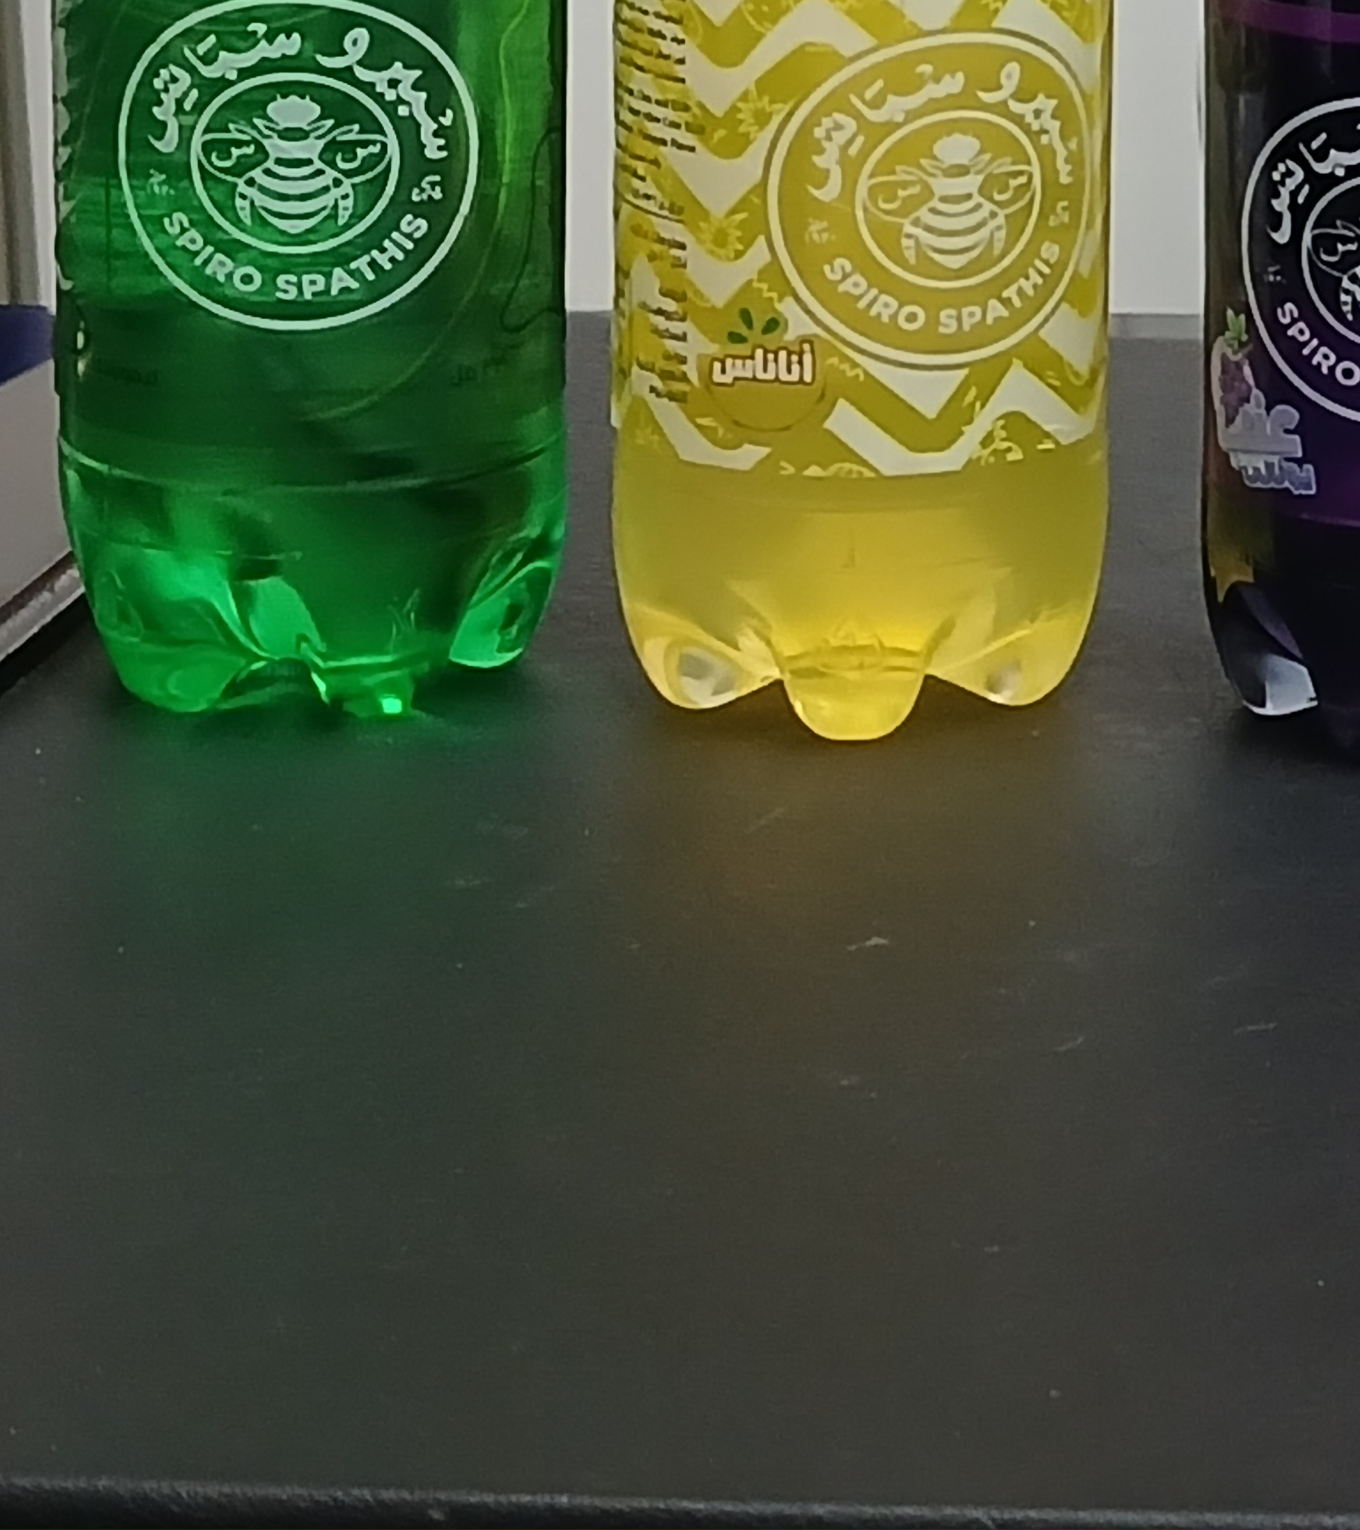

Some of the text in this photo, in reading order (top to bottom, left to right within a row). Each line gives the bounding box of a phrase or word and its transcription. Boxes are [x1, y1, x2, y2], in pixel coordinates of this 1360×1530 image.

[163, 210, 429, 301] SPIRO SPATHIS
[823, 241, 1062, 334] SPIRO SPATHIS
[711, 343, 813, 384] أناناس
